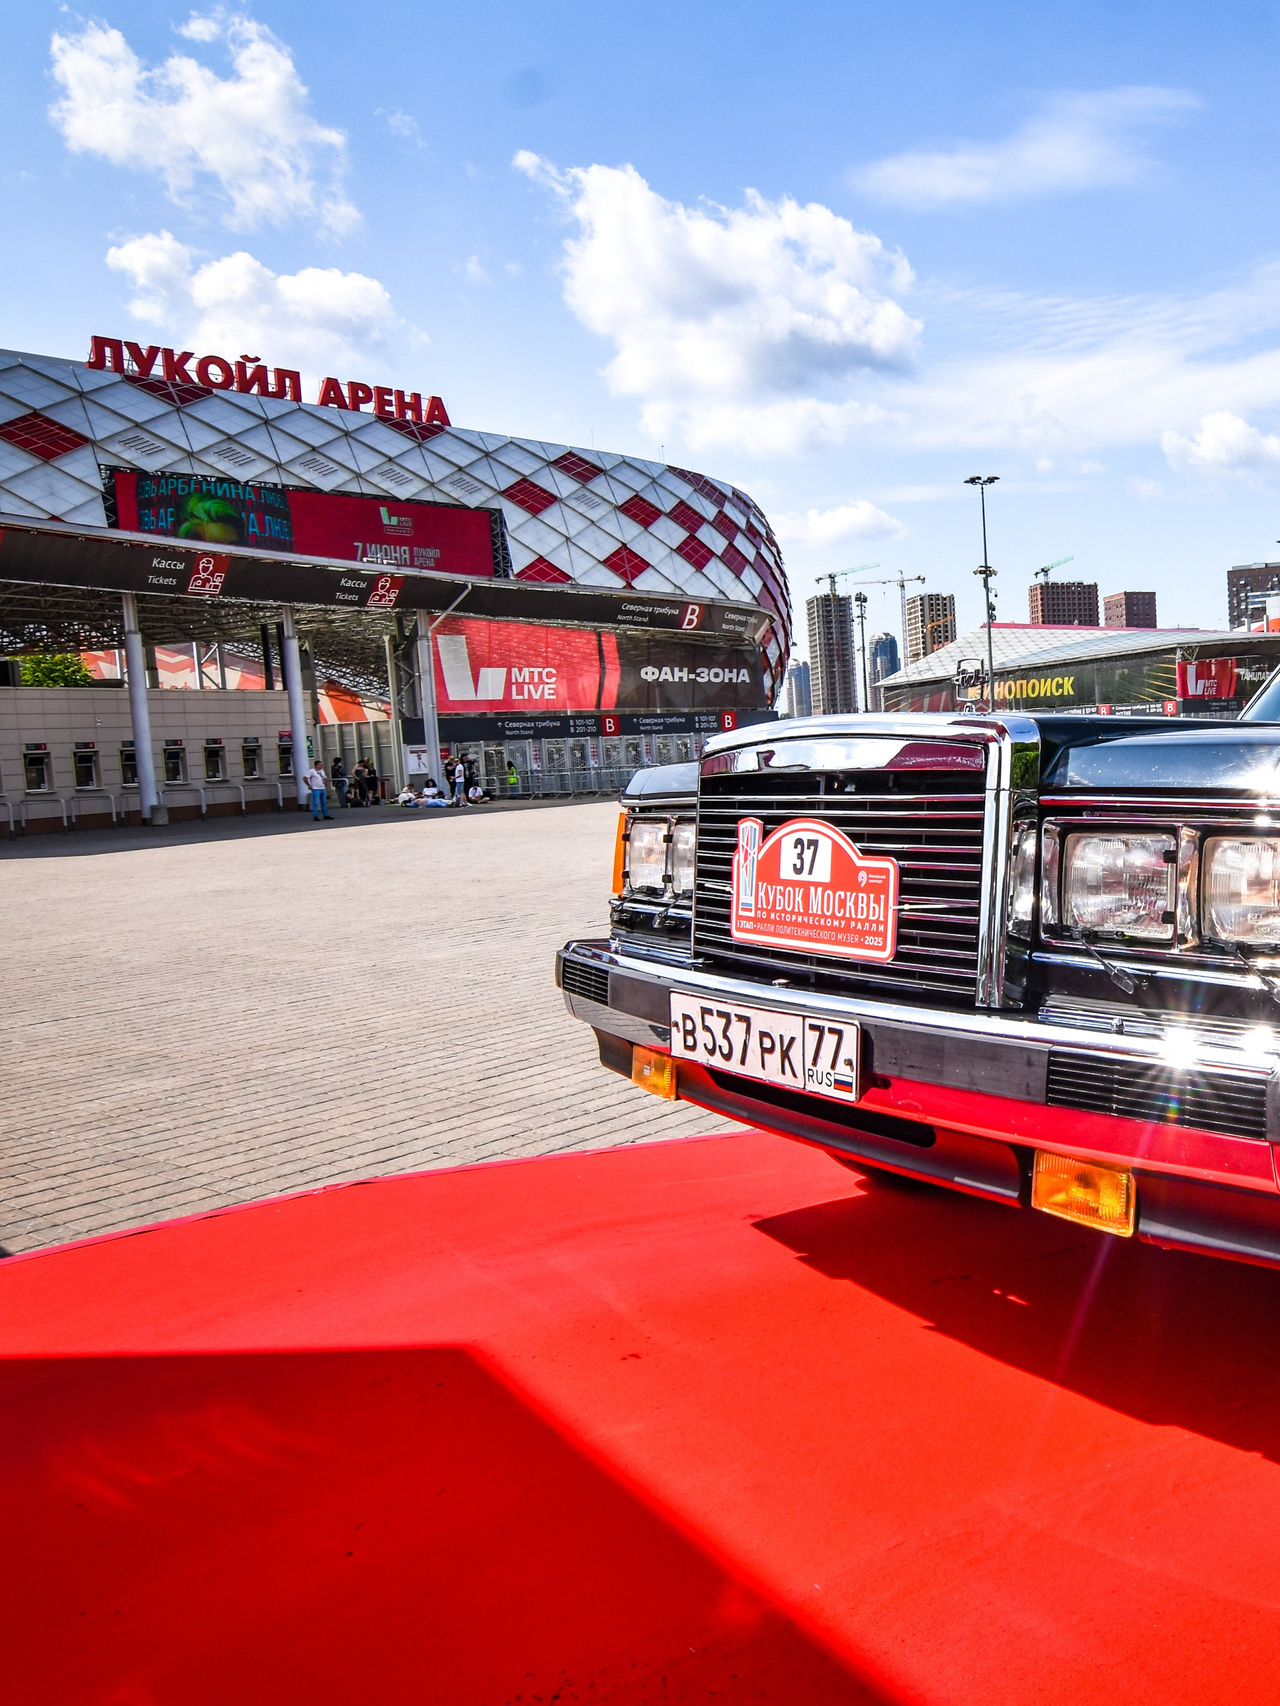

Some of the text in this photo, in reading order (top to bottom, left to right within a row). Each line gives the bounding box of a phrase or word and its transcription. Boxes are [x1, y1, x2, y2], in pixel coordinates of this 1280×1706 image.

[86, 335, 451, 426] ЛУКОЙЛ АРЕНА
[353, 542, 410, 565] 7 ИЮНЯ
[152, 558, 185, 569] Кассы
[148, 575, 177, 585] Tickets
[340, 578, 367, 588] Кассы
[335, 592, 359, 601] Tickets
[621, 603, 679, 616] Северная трибуна
[617, 614, 632, 622] North
[511, 668, 556, 683] МТС
[640, 665, 750, 683] ФАН-ЗОНА
[512, 685, 556, 699] LIVE
[535, 720, 560, 728] трибуна
[792, 837, 819, 876] 37
[757, 911, 884, 932] ПО ИСТОРИЧЕСКОМУ РАЛЛИ
[757, 922, 775, 932] РАЛЛИ
[776, 924, 835, 941] ПОЛИТЕХНИЧЕСКОГО
[837, 933, 858, 943] МУЗЕЯ
[864, 936, 883, 946] 2025
[808, 1023, 844, 1071] 77
[808, 1068, 833, 1087] RUS
